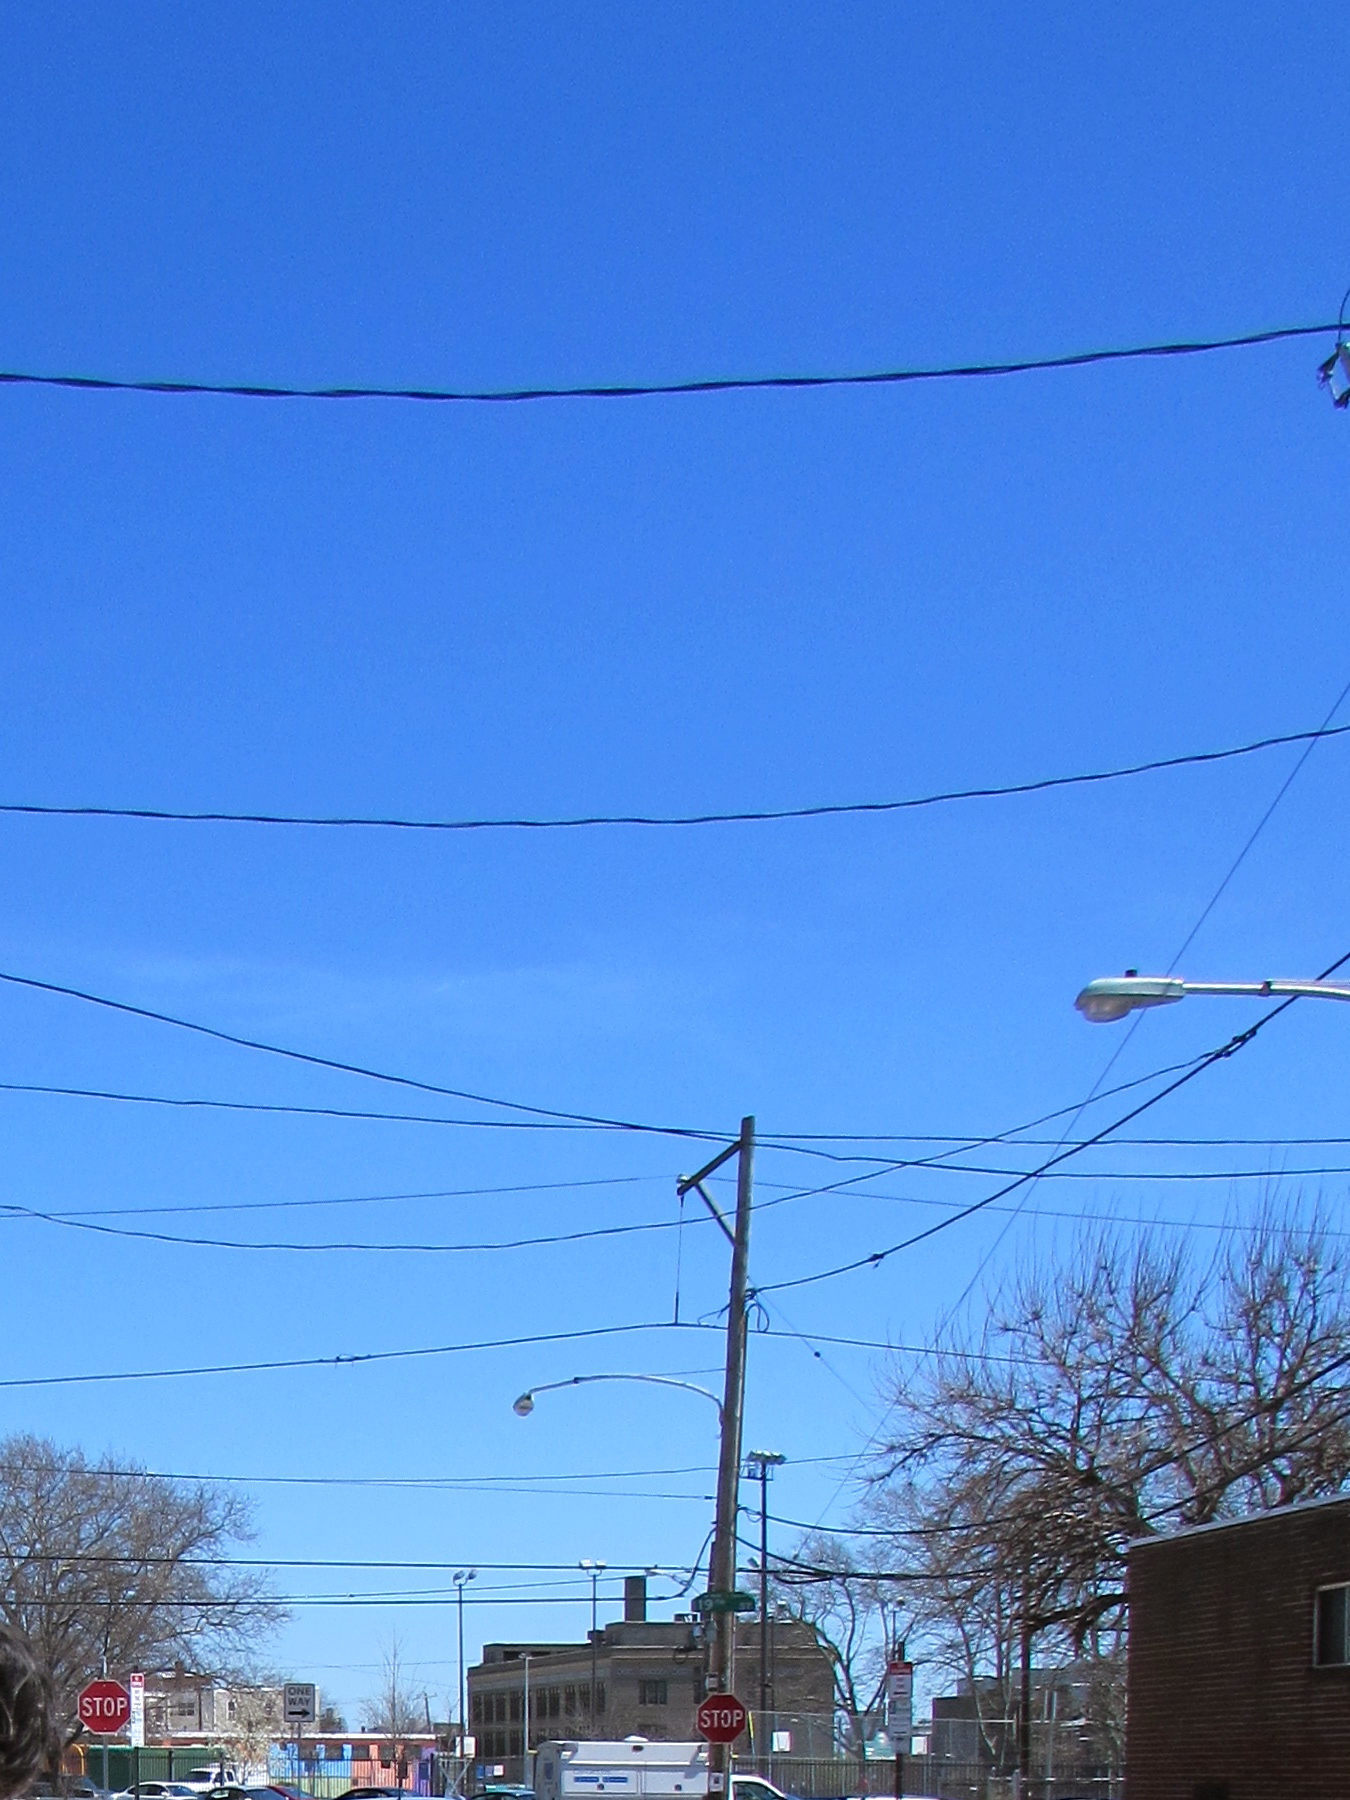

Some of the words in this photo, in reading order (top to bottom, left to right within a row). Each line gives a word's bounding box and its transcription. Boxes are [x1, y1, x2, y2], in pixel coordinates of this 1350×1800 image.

[288, 1687, 312, 1696] ONE
[81, 1697, 128, 1717] STOP
[288, 1697, 310, 1706] WAY
[700, 1709, 743, 1728] STOP
